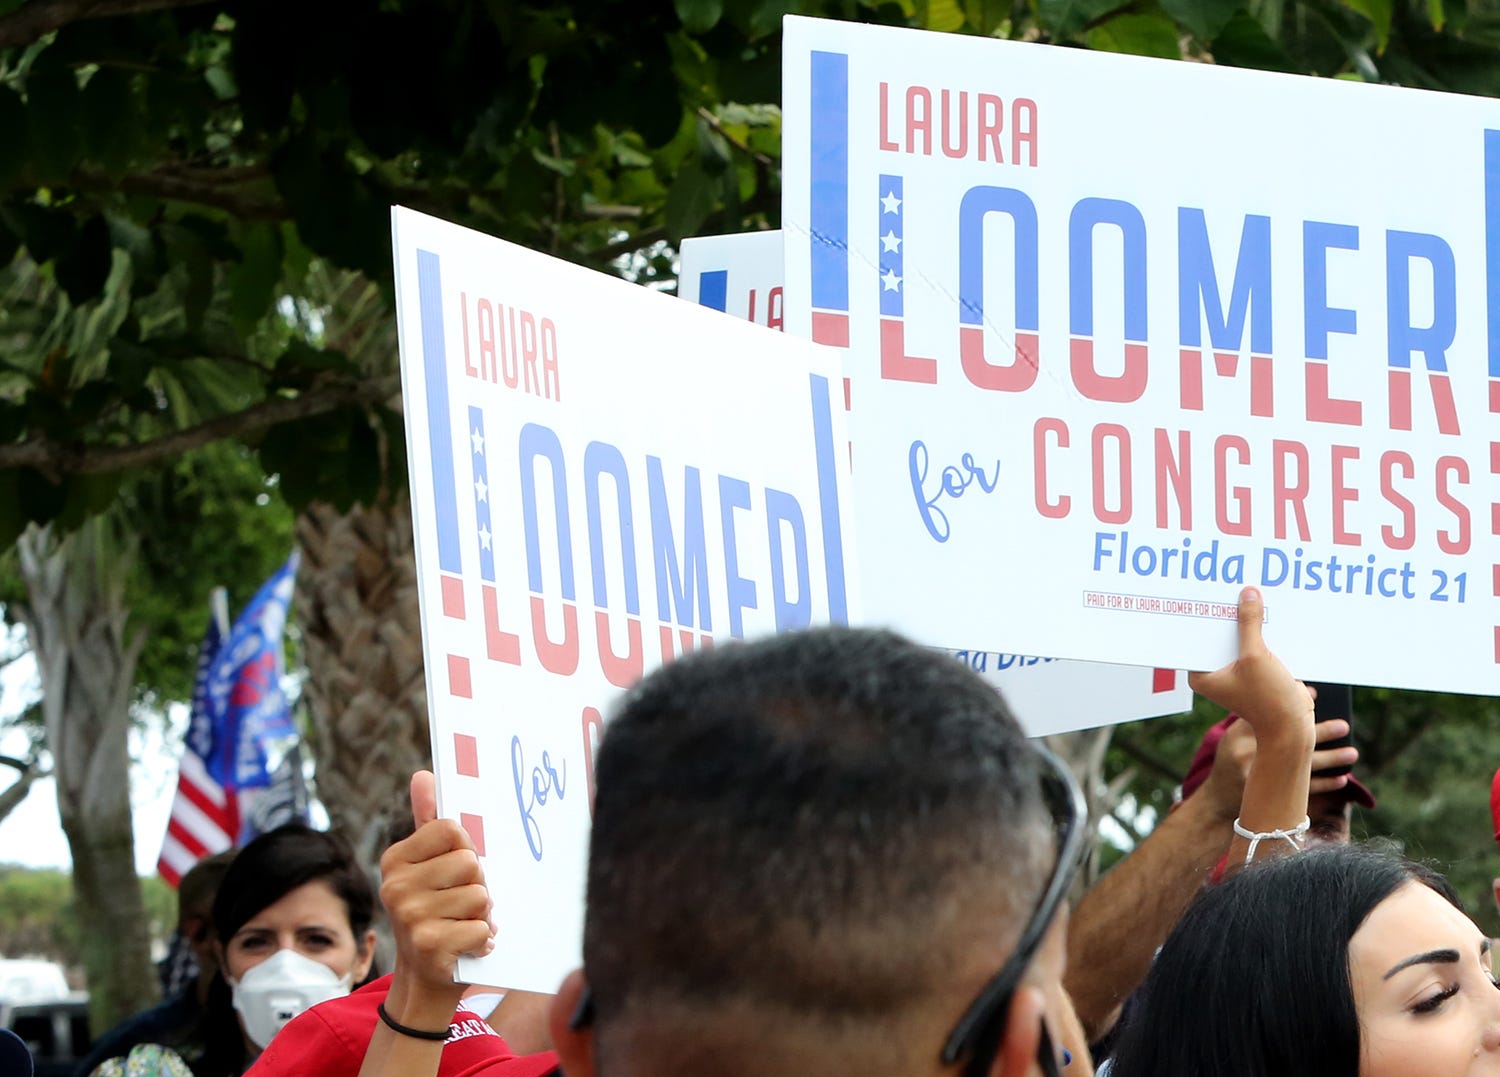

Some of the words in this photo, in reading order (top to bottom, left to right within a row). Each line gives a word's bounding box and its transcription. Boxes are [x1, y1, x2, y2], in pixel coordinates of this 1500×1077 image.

[879, 82, 1038, 167] LAURA
[460, 291, 561, 402] LAURA
[878, 174, 1461, 436] LOOMER
[909, 439, 1001, 543] for
[1033, 416, 1472, 555] CONGRESS
[1087, 593, 1105, 607] PAID
[1107, 595, 1122, 609] FOR
[1124, 597, 1134, 609] BY
[1136, 598, 1161, 612] LAURA
[1162, 600, 1193, 614] LOOMER
[1195, 603, 1210, 616] FOR
[1211, 605, 1239, 619] CONGR
[1092, 532, 1245, 586] Florida
[1260, 547, 1417, 600] District
[1430, 569, 1469, 604] 21
[511, 734, 567, 862] for
